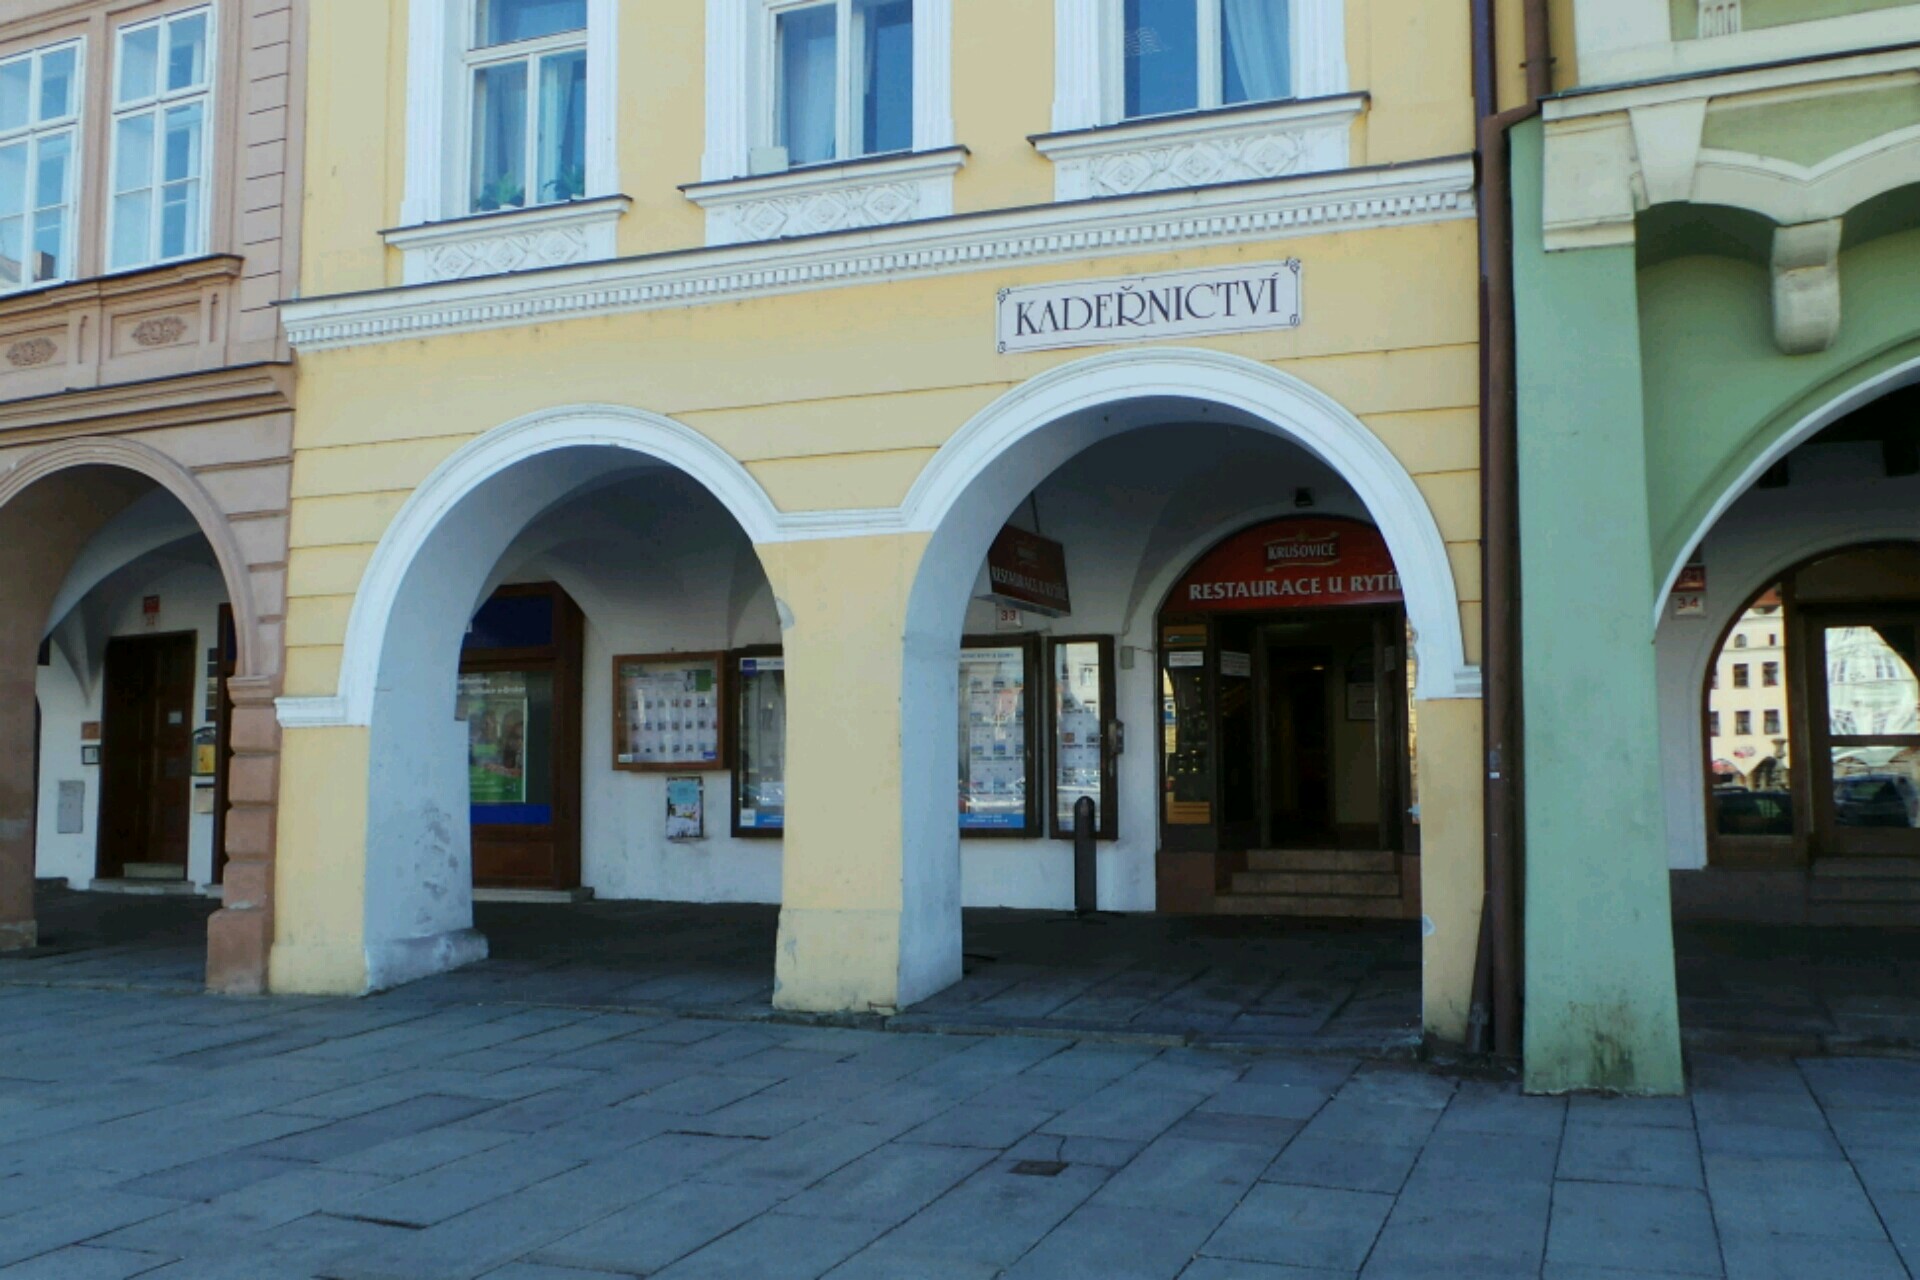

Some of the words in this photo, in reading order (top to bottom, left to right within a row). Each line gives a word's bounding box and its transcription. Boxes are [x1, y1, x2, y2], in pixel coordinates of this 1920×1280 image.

[1014, 272, 1279, 337] KADEŘNICTVÍ
[1267, 542, 1336, 561] KRUŠOVICE
[1189, 576, 1322, 601] RESTAURACE
[1328, 575, 1342, 593] U
